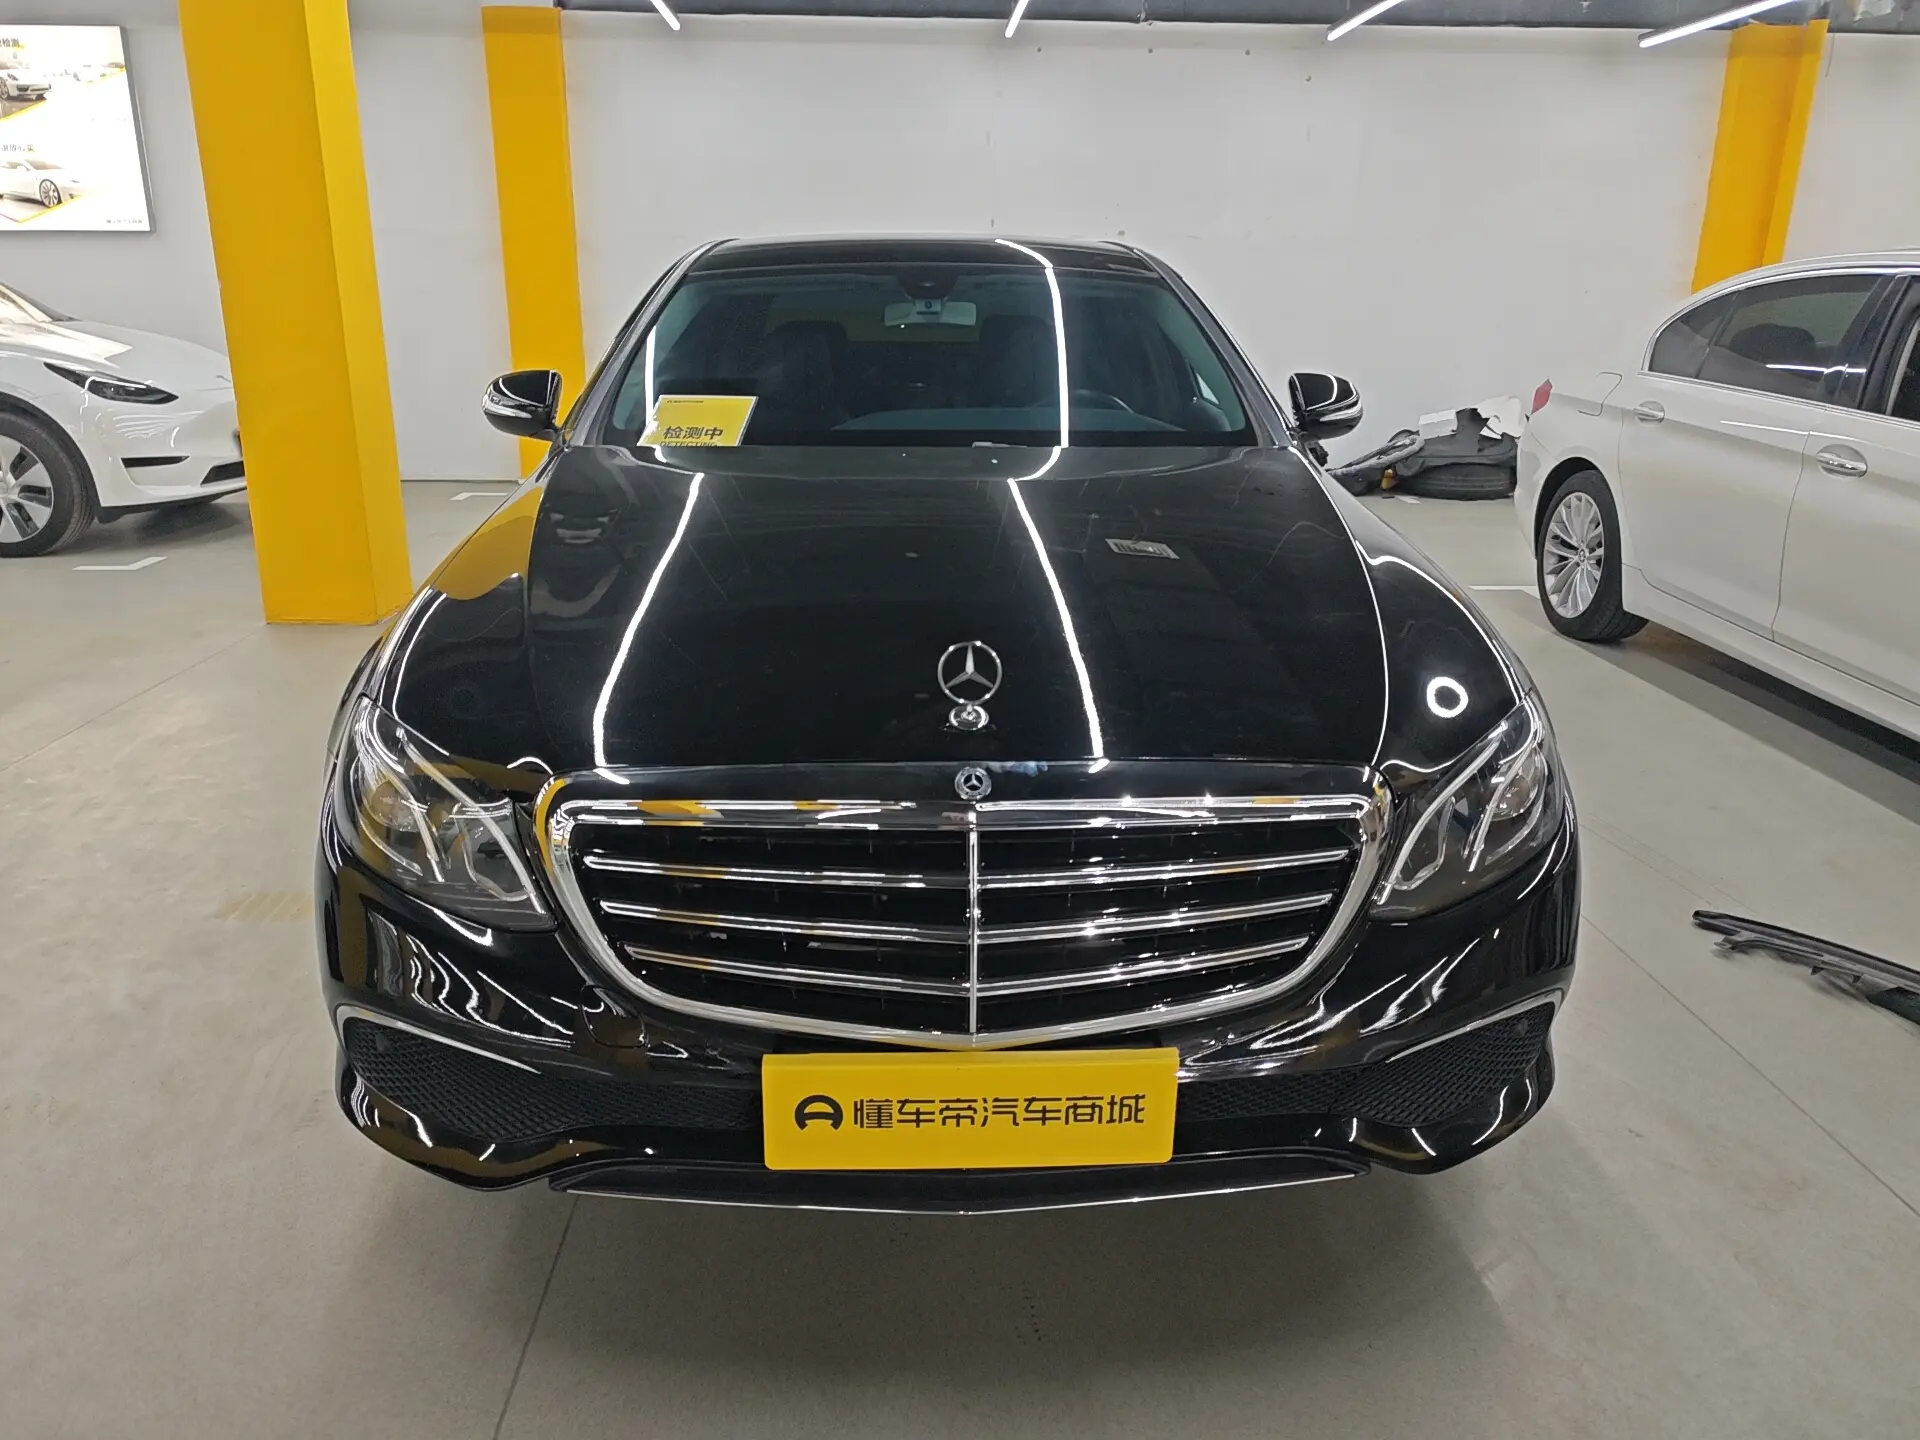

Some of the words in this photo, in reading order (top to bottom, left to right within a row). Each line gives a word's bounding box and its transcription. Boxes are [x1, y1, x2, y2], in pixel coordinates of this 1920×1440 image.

[663, 426, 723, 440] 检测中
[853, 1093, 1147, 1129] 懂车帝汽车商城
